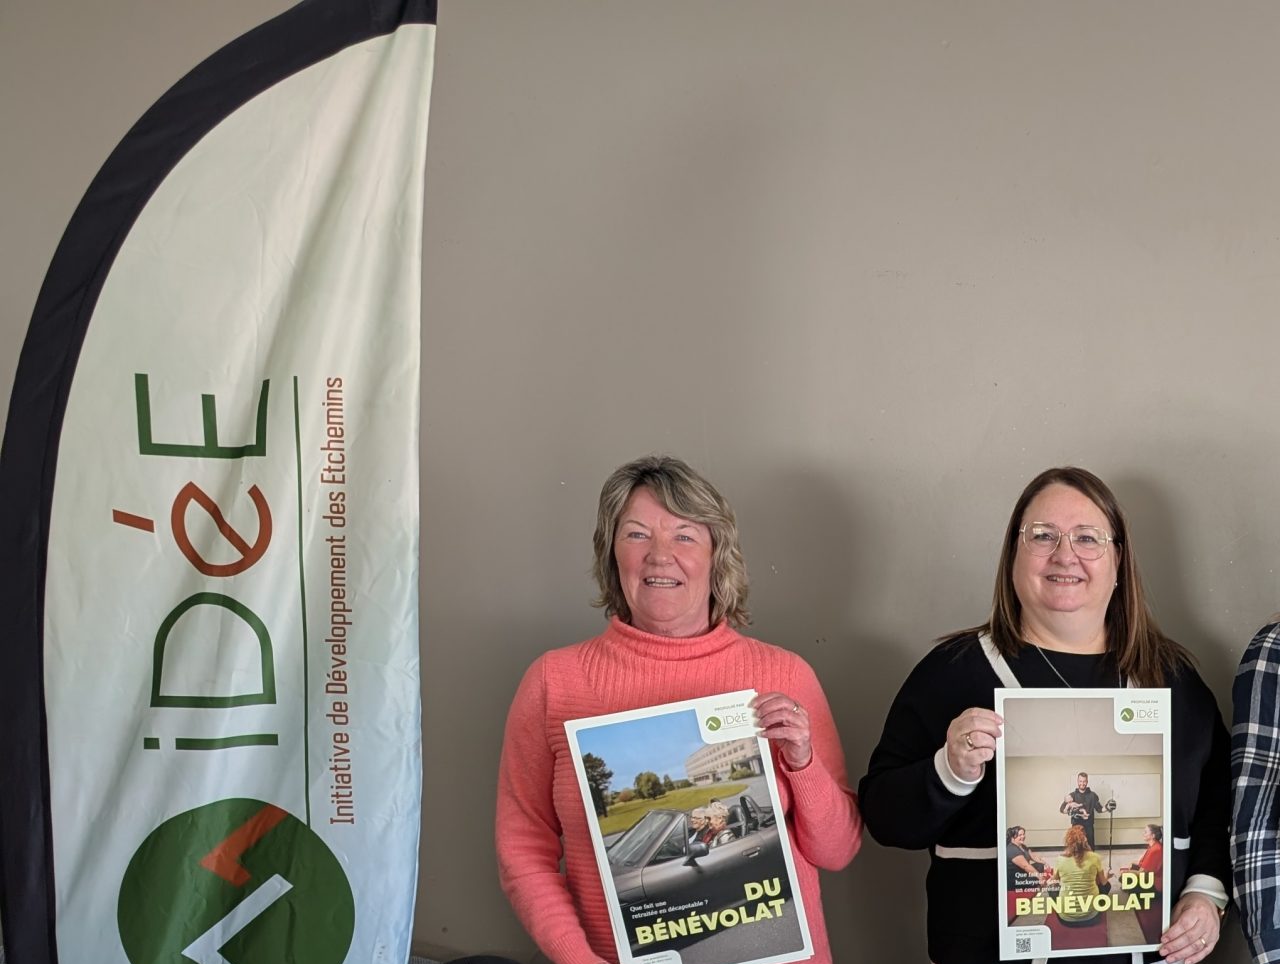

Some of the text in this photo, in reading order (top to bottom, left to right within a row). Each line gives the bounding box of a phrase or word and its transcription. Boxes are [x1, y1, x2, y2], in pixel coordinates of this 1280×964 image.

[320, 377, 354, 824] Initiative de Développement des Etchemins
[744, 877, 781, 901] DU
[1121, 872, 1154, 890] DU
[1015, 891, 1155, 916] BÉNÉVOLAT
[635, 898, 785, 945] BÉNÉVOLAT
